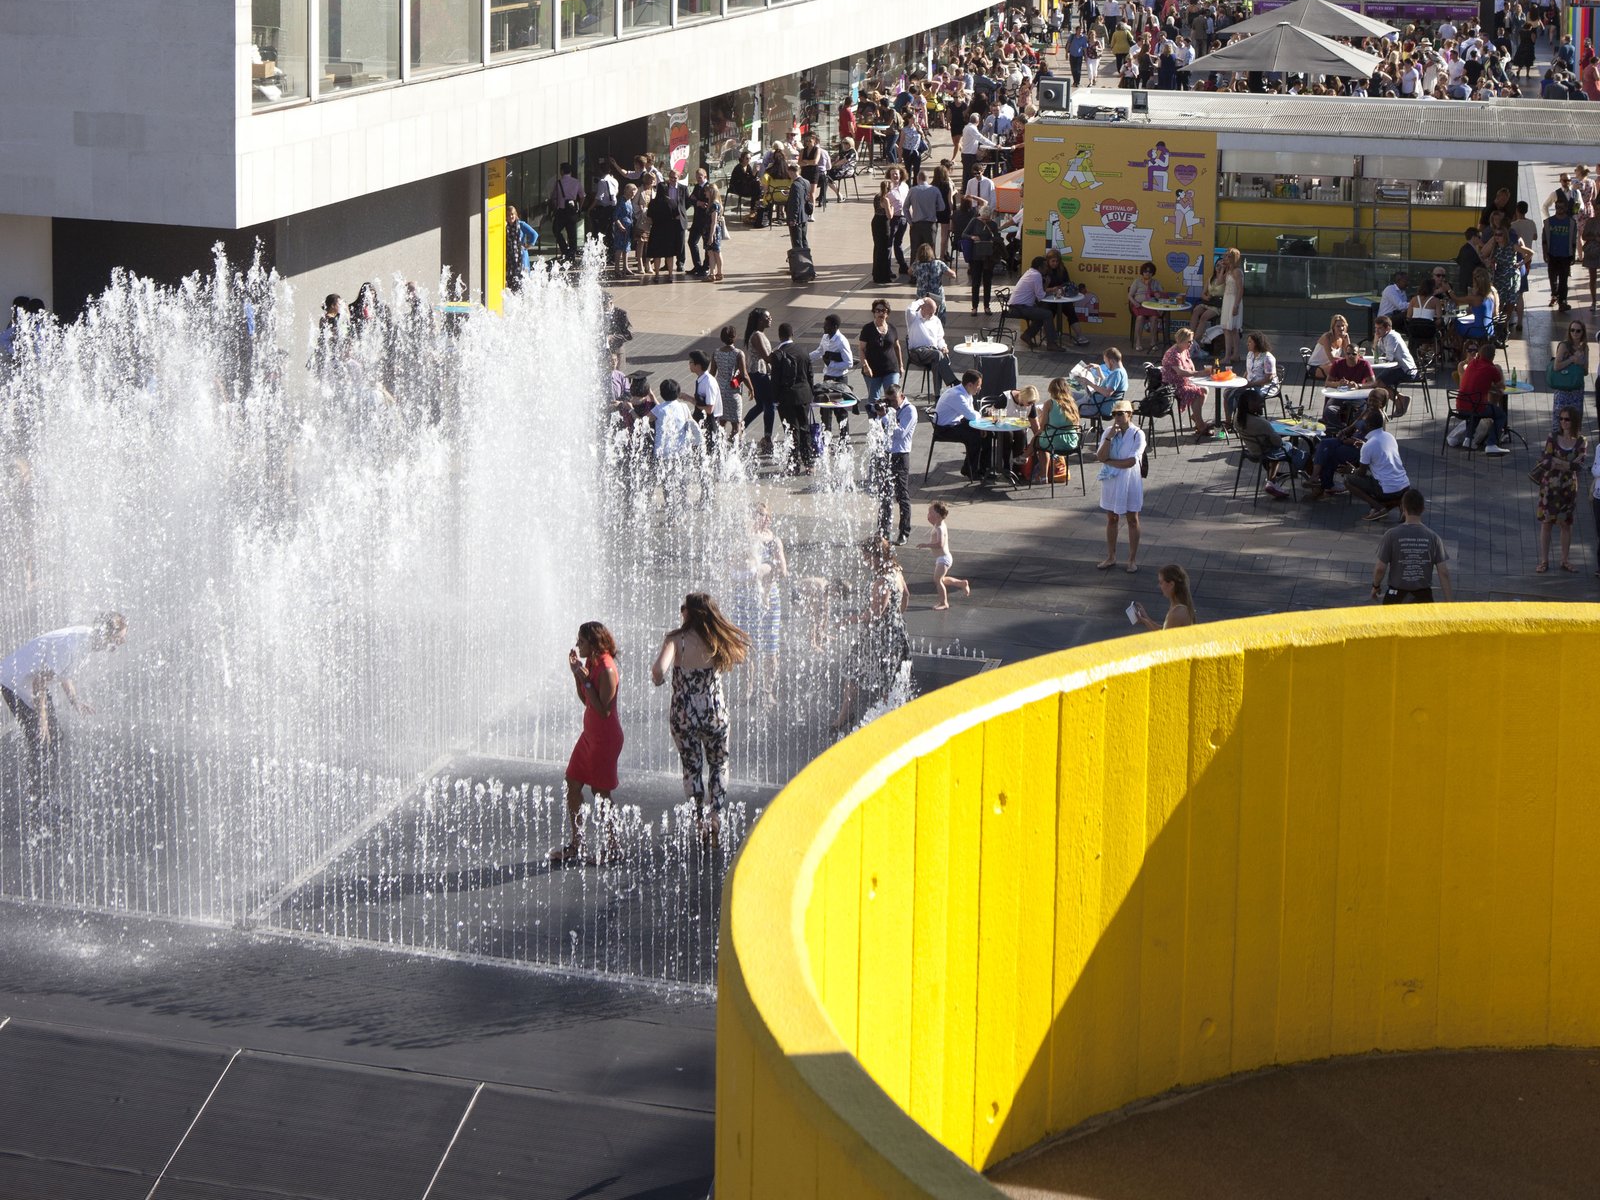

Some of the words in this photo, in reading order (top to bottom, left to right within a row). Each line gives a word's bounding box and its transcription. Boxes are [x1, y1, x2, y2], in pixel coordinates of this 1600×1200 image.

[1106, 212, 1132, 222] LOVE
[1078, 263, 1109, 273] COME
[1113, 265, 1141, 275] INSI
